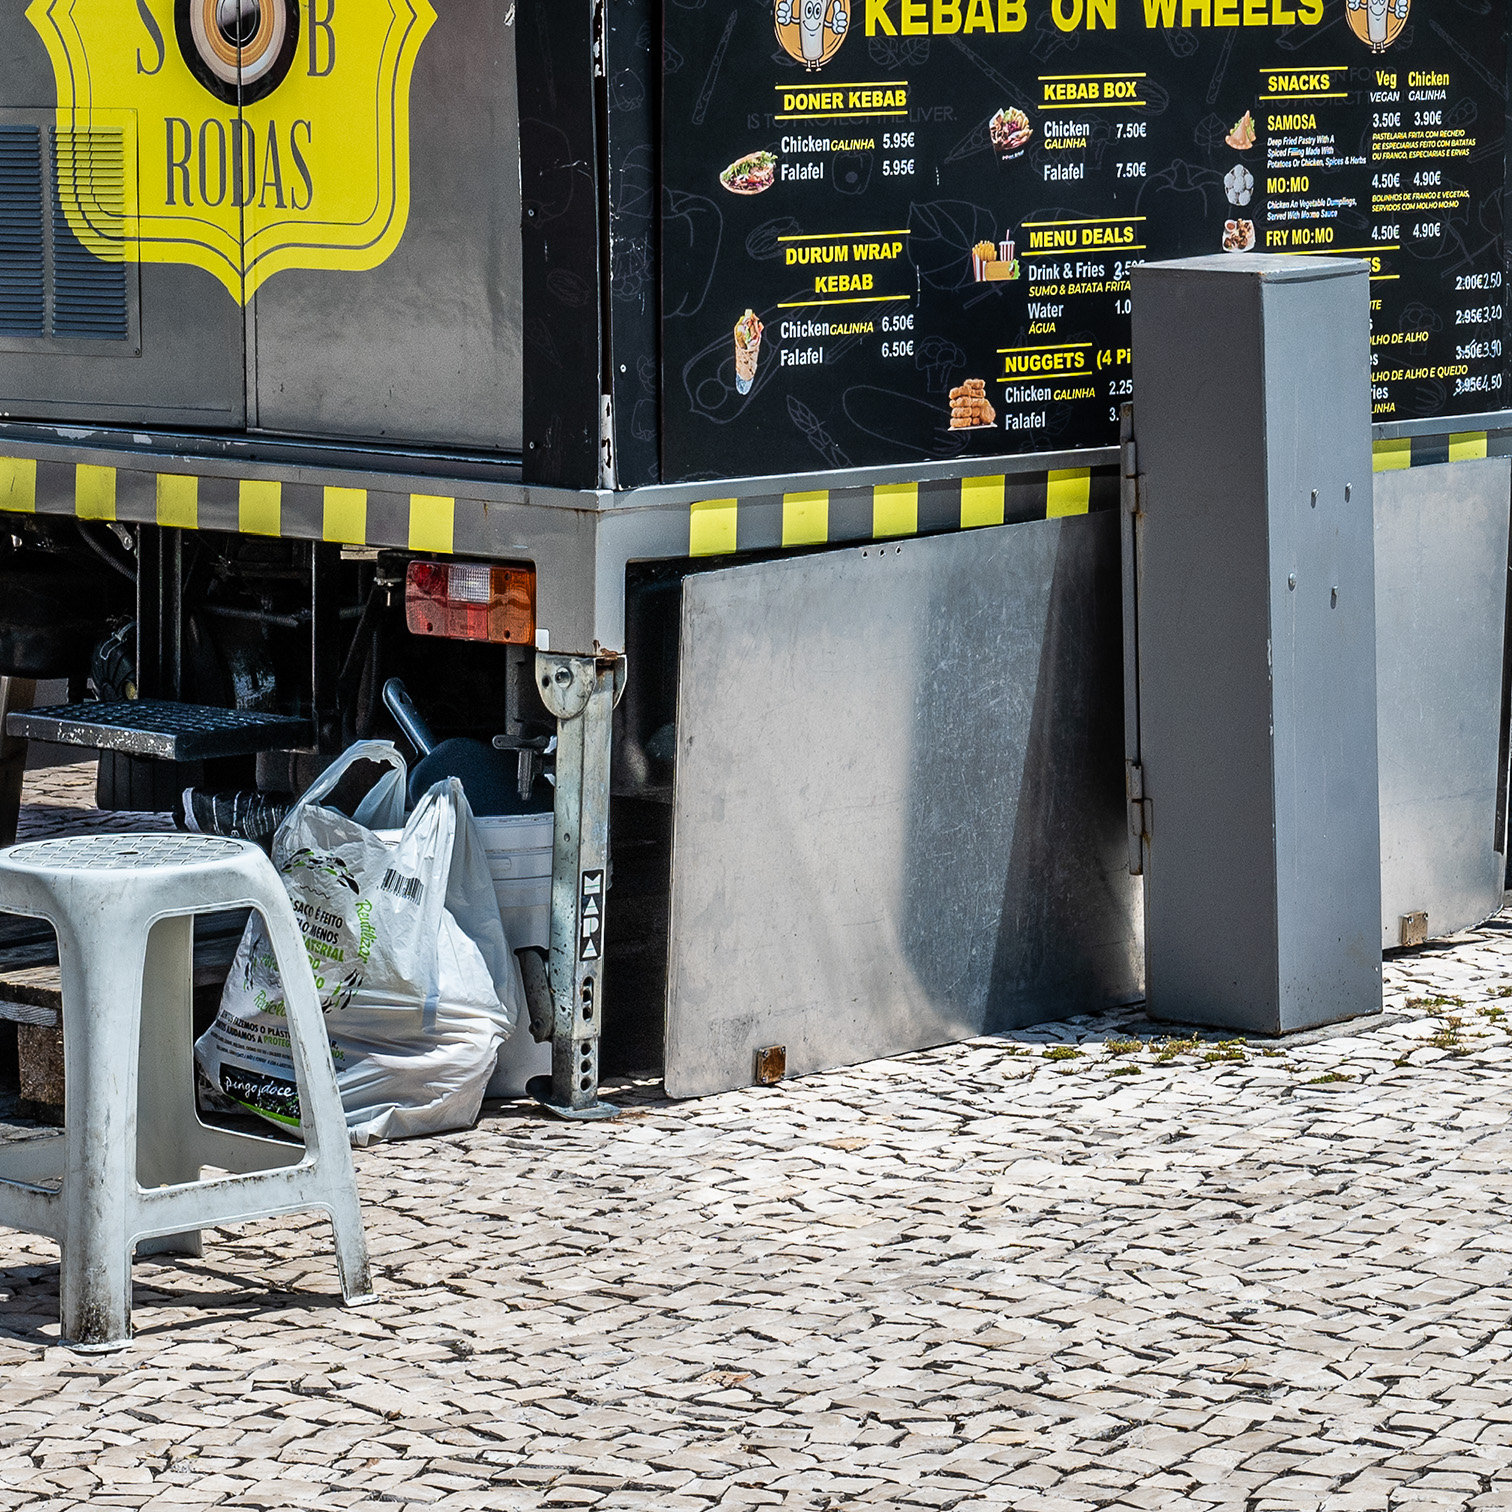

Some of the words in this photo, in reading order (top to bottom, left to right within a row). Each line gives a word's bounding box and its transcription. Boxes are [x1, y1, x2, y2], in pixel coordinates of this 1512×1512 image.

[1268, 74, 1330, 93] SNACKS
[1375, 70, 1397, 90] Veg
[1407, 70, 1450, 88] Chicken
[783, 91, 844, 111] DONER
[848, 89, 907, 109] KEBAB
[1043, 83, 1100, 101] KEBAB
[1103, 81, 1137, 99] BOX
[1370, 91, 1400, 103] VEGAN
[1408, 89, 1447, 102] GALINHA
[1044, 120, 1090, 138] Chicken
[1116, 122, 1147, 139] 7.50€
[1267, 113, 1317, 131] SAMOSA
[1372, 112, 1401, 128] 3.50€
[1414, 110, 1442, 126] 3.90€
[780, 135, 830, 153] Chicken
[830, 138, 875, 152] GALINHA
[882, 131, 915, 149] 5.95€
[1044, 138, 1087, 150] GALINHA
[164, 117, 314, 211] RODAS
[780, 162, 824, 181] Falafel
[882, 159, 915, 177] 5.95€
[1043, 162, 1084, 181] Falafel
[1116, 162, 1147, 178] 7.50€
[1267, 175, 1309, 194] MO:MO
[1371, 172, 1400, 188] 4.50€
[1413, 171, 1441, 187] 4.90€
[1030, 229, 1077, 249] MENU
[1082, 226, 1134, 246] DEALS
[1266, 230, 1288, 247] FRY
[1291, 227, 1334, 245] MO:MO
[1371, 224, 1400, 241] 4.50€
[1412, 222, 1441, 238] 4.90€
[785, 245, 849, 266] DURUM
[853, 241, 903, 262] WRAP
[1028, 263, 1060, 282] Drink
[1062, 263, 1073, 279] &
[1076, 260, 1105, 278] Fries
[814, 273, 874, 294] KEBAB
[1028, 285, 1058, 297] SUMO
[1059, 284, 1066, 295] &
[1068, 282, 1103, 294] BATATA
[1028, 302, 1064, 319] Water
[780, 320, 830, 339] Chicken
[829, 321, 874, 336] GALINHA
[881, 314, 915, 332] 6.50€
[1028, 320, 1056, 335] ÁGUA
[1391, 333, 1403, 343] DE
[1405, 331, 1429, 343] ALHO
[780, 346, 824, 366] Falafel
[881, 340, 914, 358] 6.50€
[1004, 351, 1085, 373] NUGGETS
[1391, 369, 1403, 380] DE
[1404, 368, 1429, 380] ALHO
[1430, 367, 1436, 377] E
[1437, 364, 1468, 379] QUEIJO
[1005, 385, 1051, 404] Chicken
[1053, 387, 1096, 401] GALINHA
[1005, 411, 1046, 430] Falafel
[293, 900, 314, 918] SACO
[315, 906, 321, 921] É
[320, 911, 343, 929] FEITO
[582, 873, 602, 960] MAPA
[308, 924, 339, 945] MENOS
